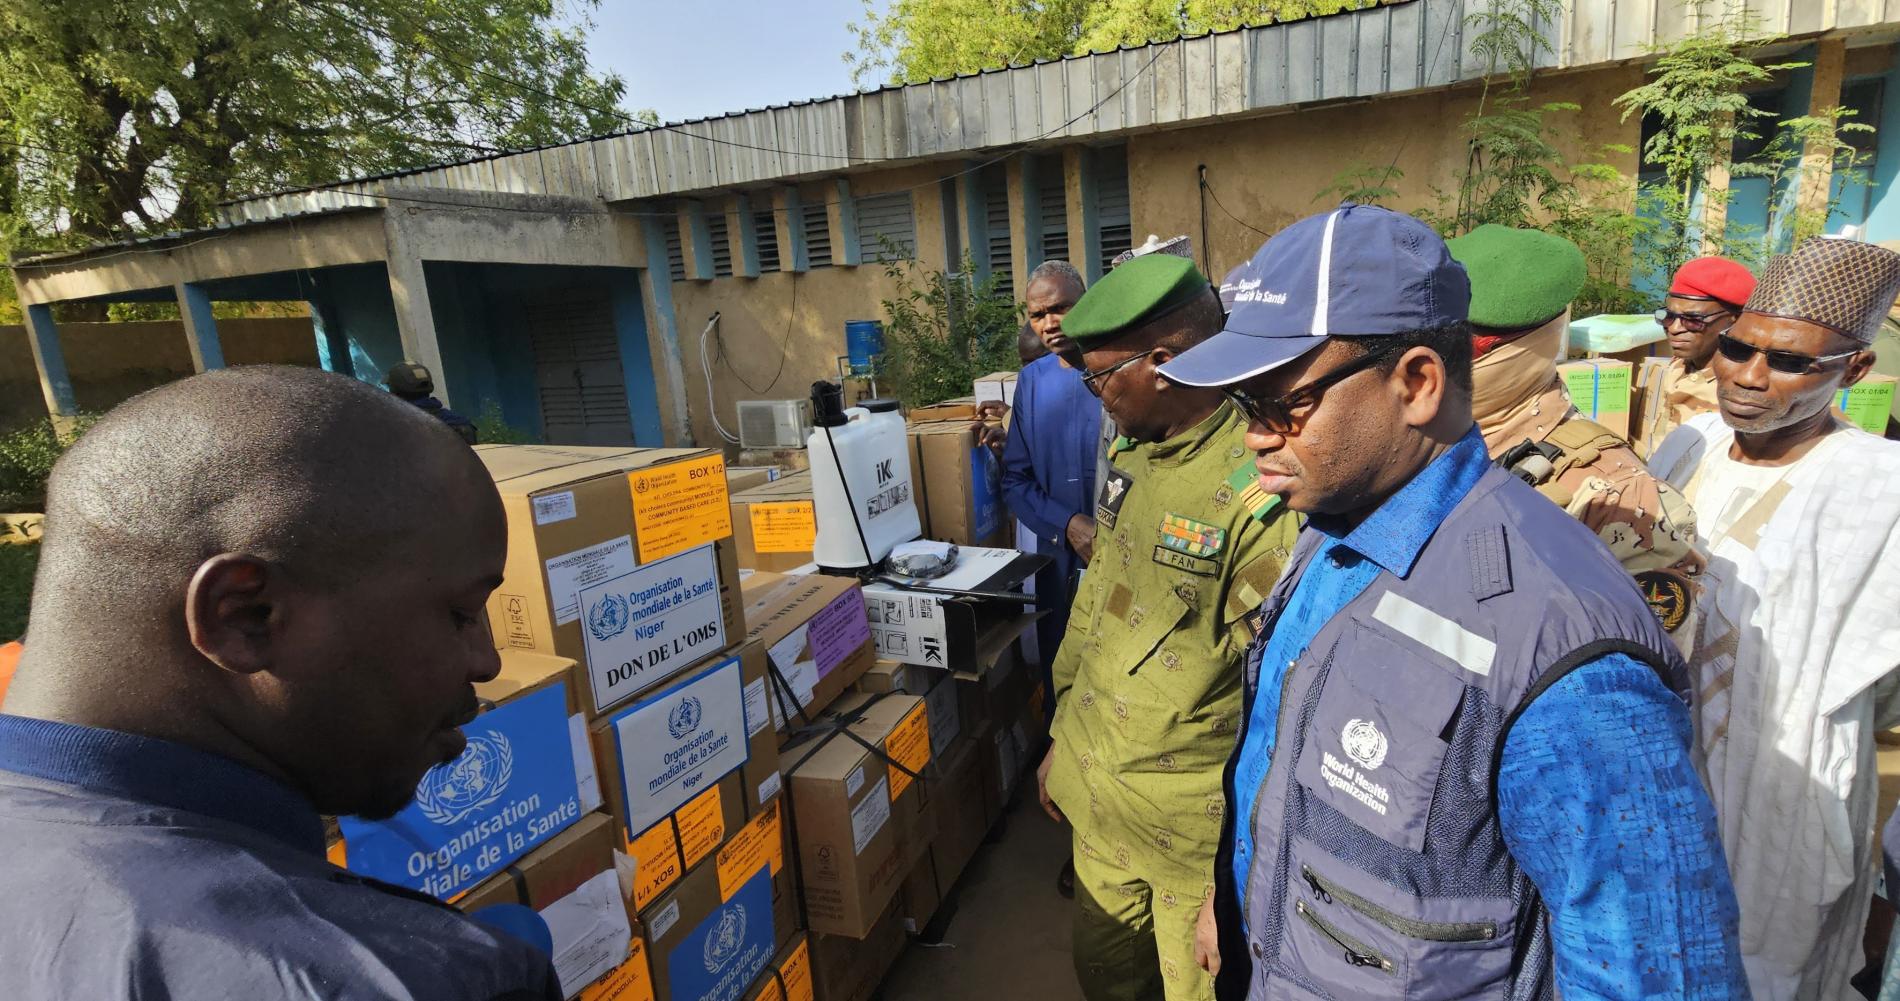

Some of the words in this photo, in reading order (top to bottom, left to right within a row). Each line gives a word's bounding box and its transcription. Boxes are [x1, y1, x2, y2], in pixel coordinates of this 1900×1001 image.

[1262, 290, 1287, 305] Santé
[689, 466, 709, 480] BOX
[712, 464, 723, 475] 1/2
[648, 509, 678, 521] COMMUNITY
[1171, 554, 1195, 570] FAN
[630, 576, 683, 606] Organisation
[632, 598, 671, 622] mondiale
[673, 592, 682, 606] de
[684, 589, 692, 600] la
[692, 578, 714, 597] Santé
[634, 620, 665, 642] Niger
[606, 655, 644, 688] DON
[648, 644, 670, 668] DE
[649, 759, 686, 791] mondiale
[688, 752, 698, 766] de
[700, 745, 708, 758] la
[708, 732, 728, 754] Santé
[664, 729, 714, 765] Organisation
[682, 771, 704, 790] Niger
[1320, 764, 1387, 816] Organization
[1323, 751, 1354, 780] World
[1354, 771, 1389, 802] Health
[408, 792, 540, 877] Organisation
[476, 845, 502, 872] de
[506, 832, 525, 854] la
[527, 796, 577, 841] Santé
[654, 865, 674, 888] BOX
[638, 884, 651, 901] 1/1
[728, 984, 740, 1000] de
[742, 971, 750, 988] la
[751, 941, 775, 978] Santé
[783, 961, 798, 980] BOX
